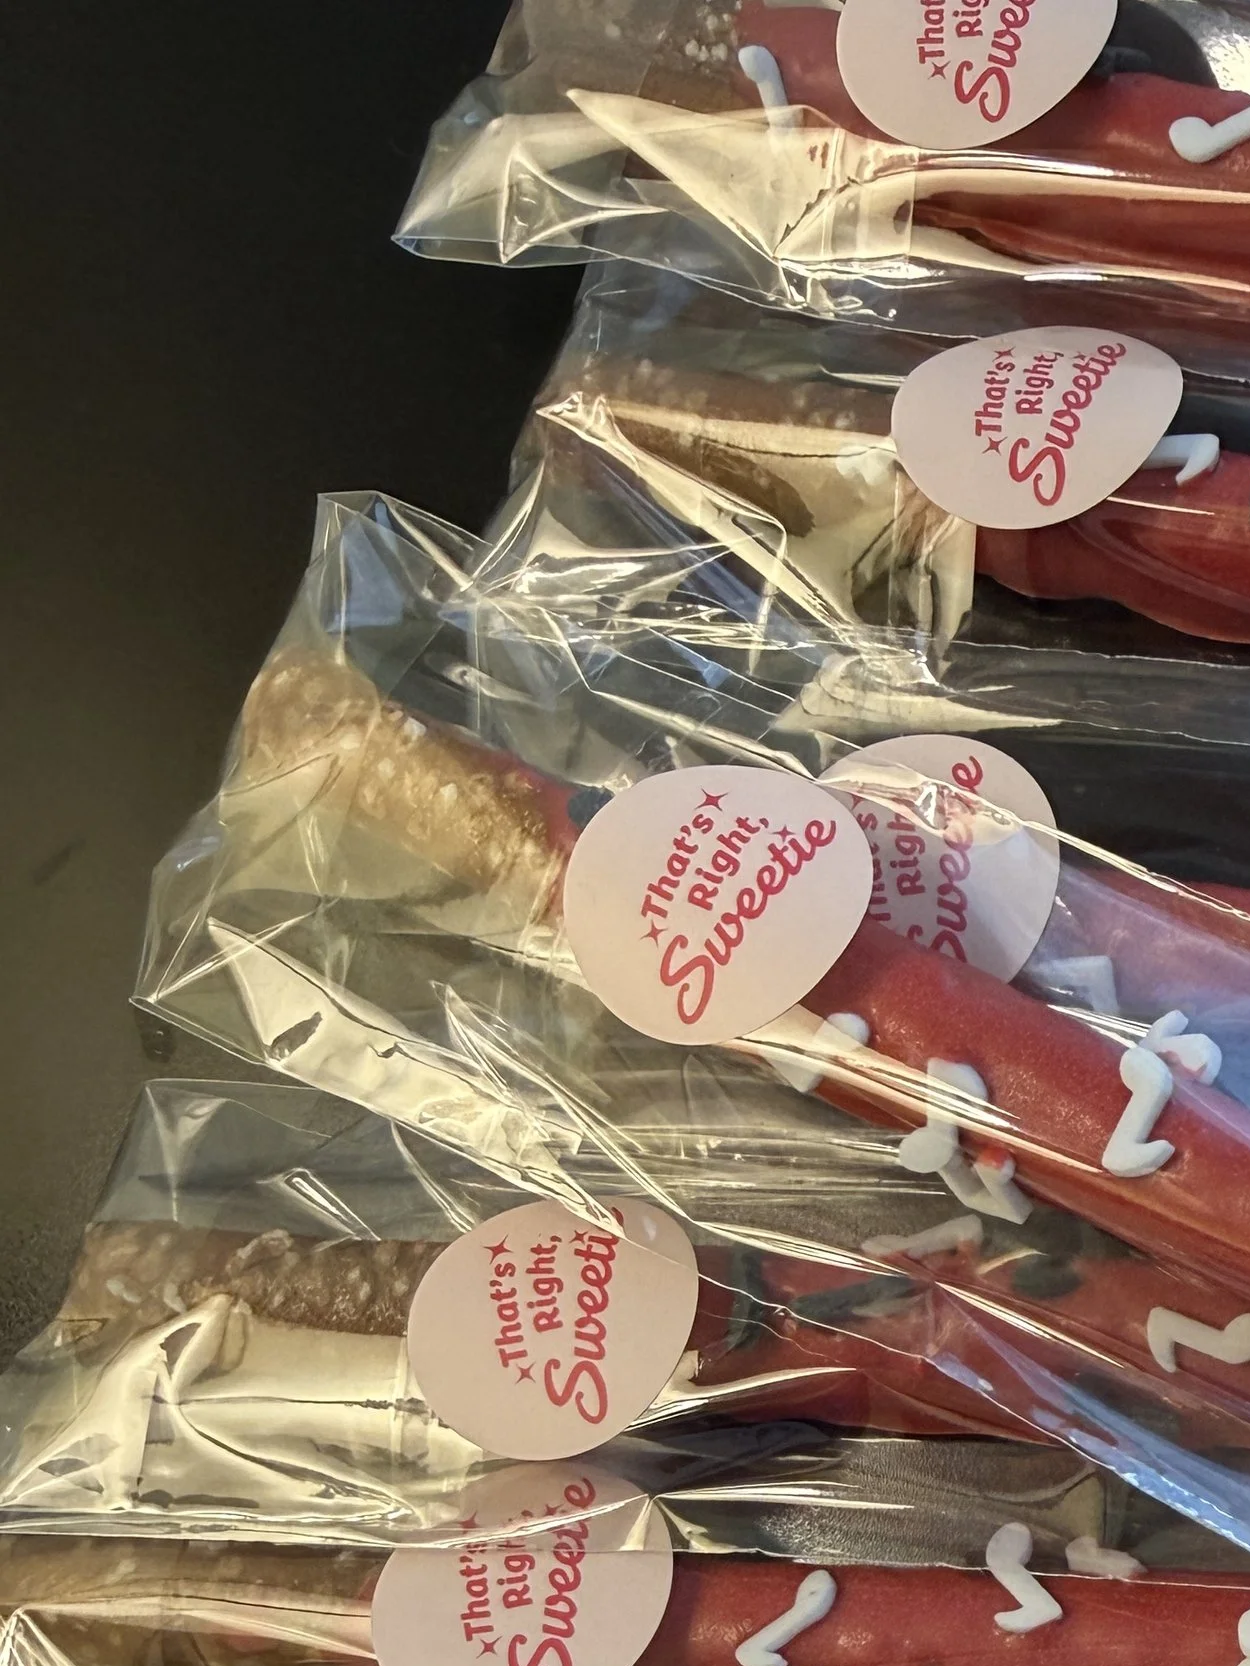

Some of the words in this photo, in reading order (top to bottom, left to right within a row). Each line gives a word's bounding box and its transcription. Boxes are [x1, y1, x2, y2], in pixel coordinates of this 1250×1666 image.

[974, 361, 1015, 436] That's
[1009, 343, 1126, 506] Sweetie
[1015, 351, 1064, 414] Right,
[640, 813, 714, 919] That's
[688, 817, 769, 911] Right,
[660, 820, 837, 1024] Sweetie
[490, 1262, 528, 1368] That's
[525, 1235, 564, 1333] Right,
